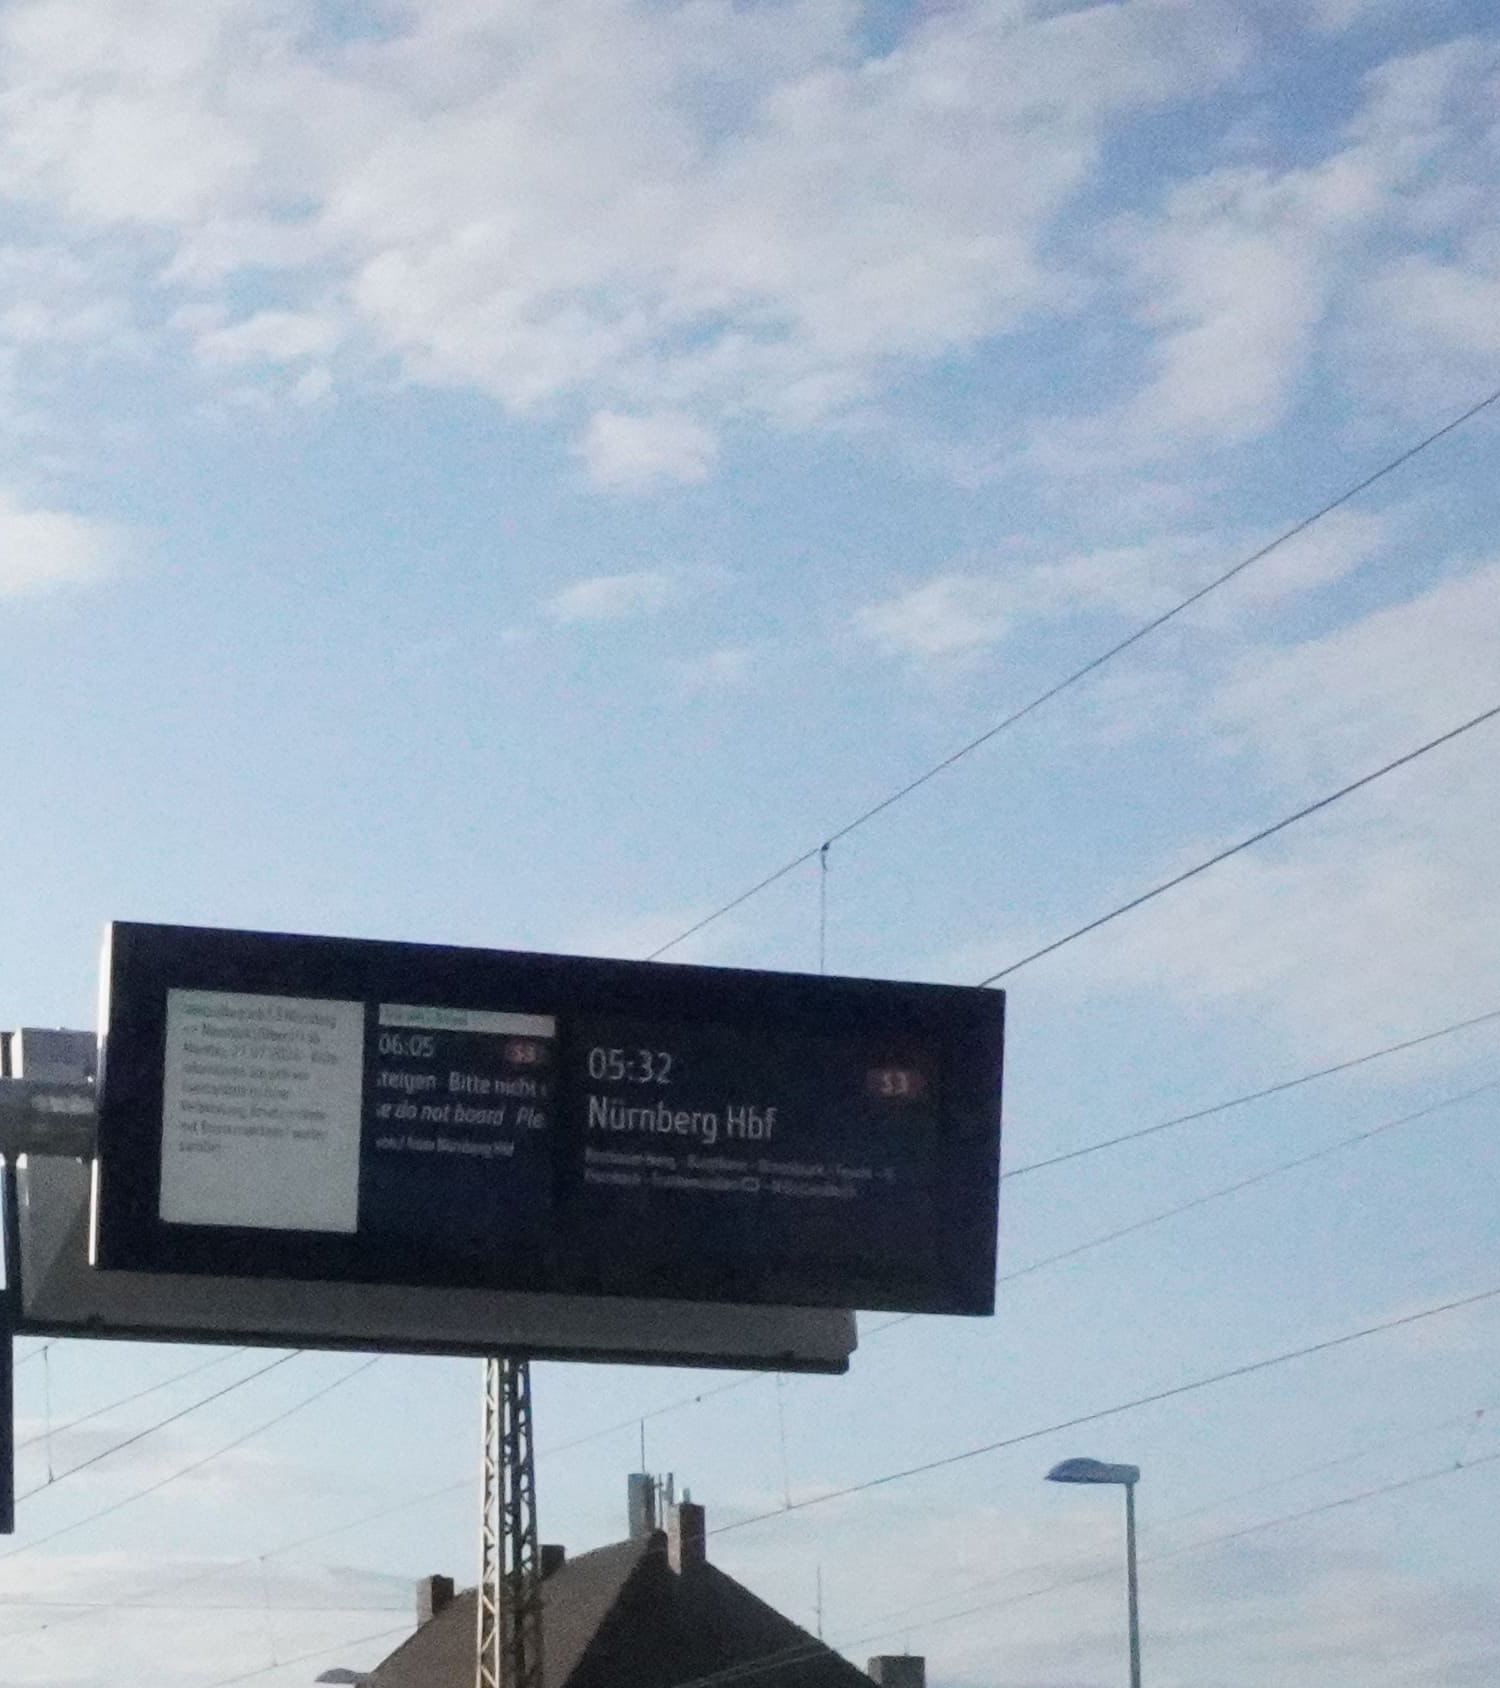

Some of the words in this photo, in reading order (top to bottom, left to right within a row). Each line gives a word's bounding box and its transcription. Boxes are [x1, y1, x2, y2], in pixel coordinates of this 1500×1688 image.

[378, 1034, 434, 1058] 06:05
[588, 1047, 672, 1084] 05:32
[449, 1071, 490, 1094] Bitte
[420, 1104, 450, 1123] not
[454, 1104, 505, 1125] board
[587, 1095, 717, 1144] Nürnberg
[726, 1105, 777, 1139] Hbf
